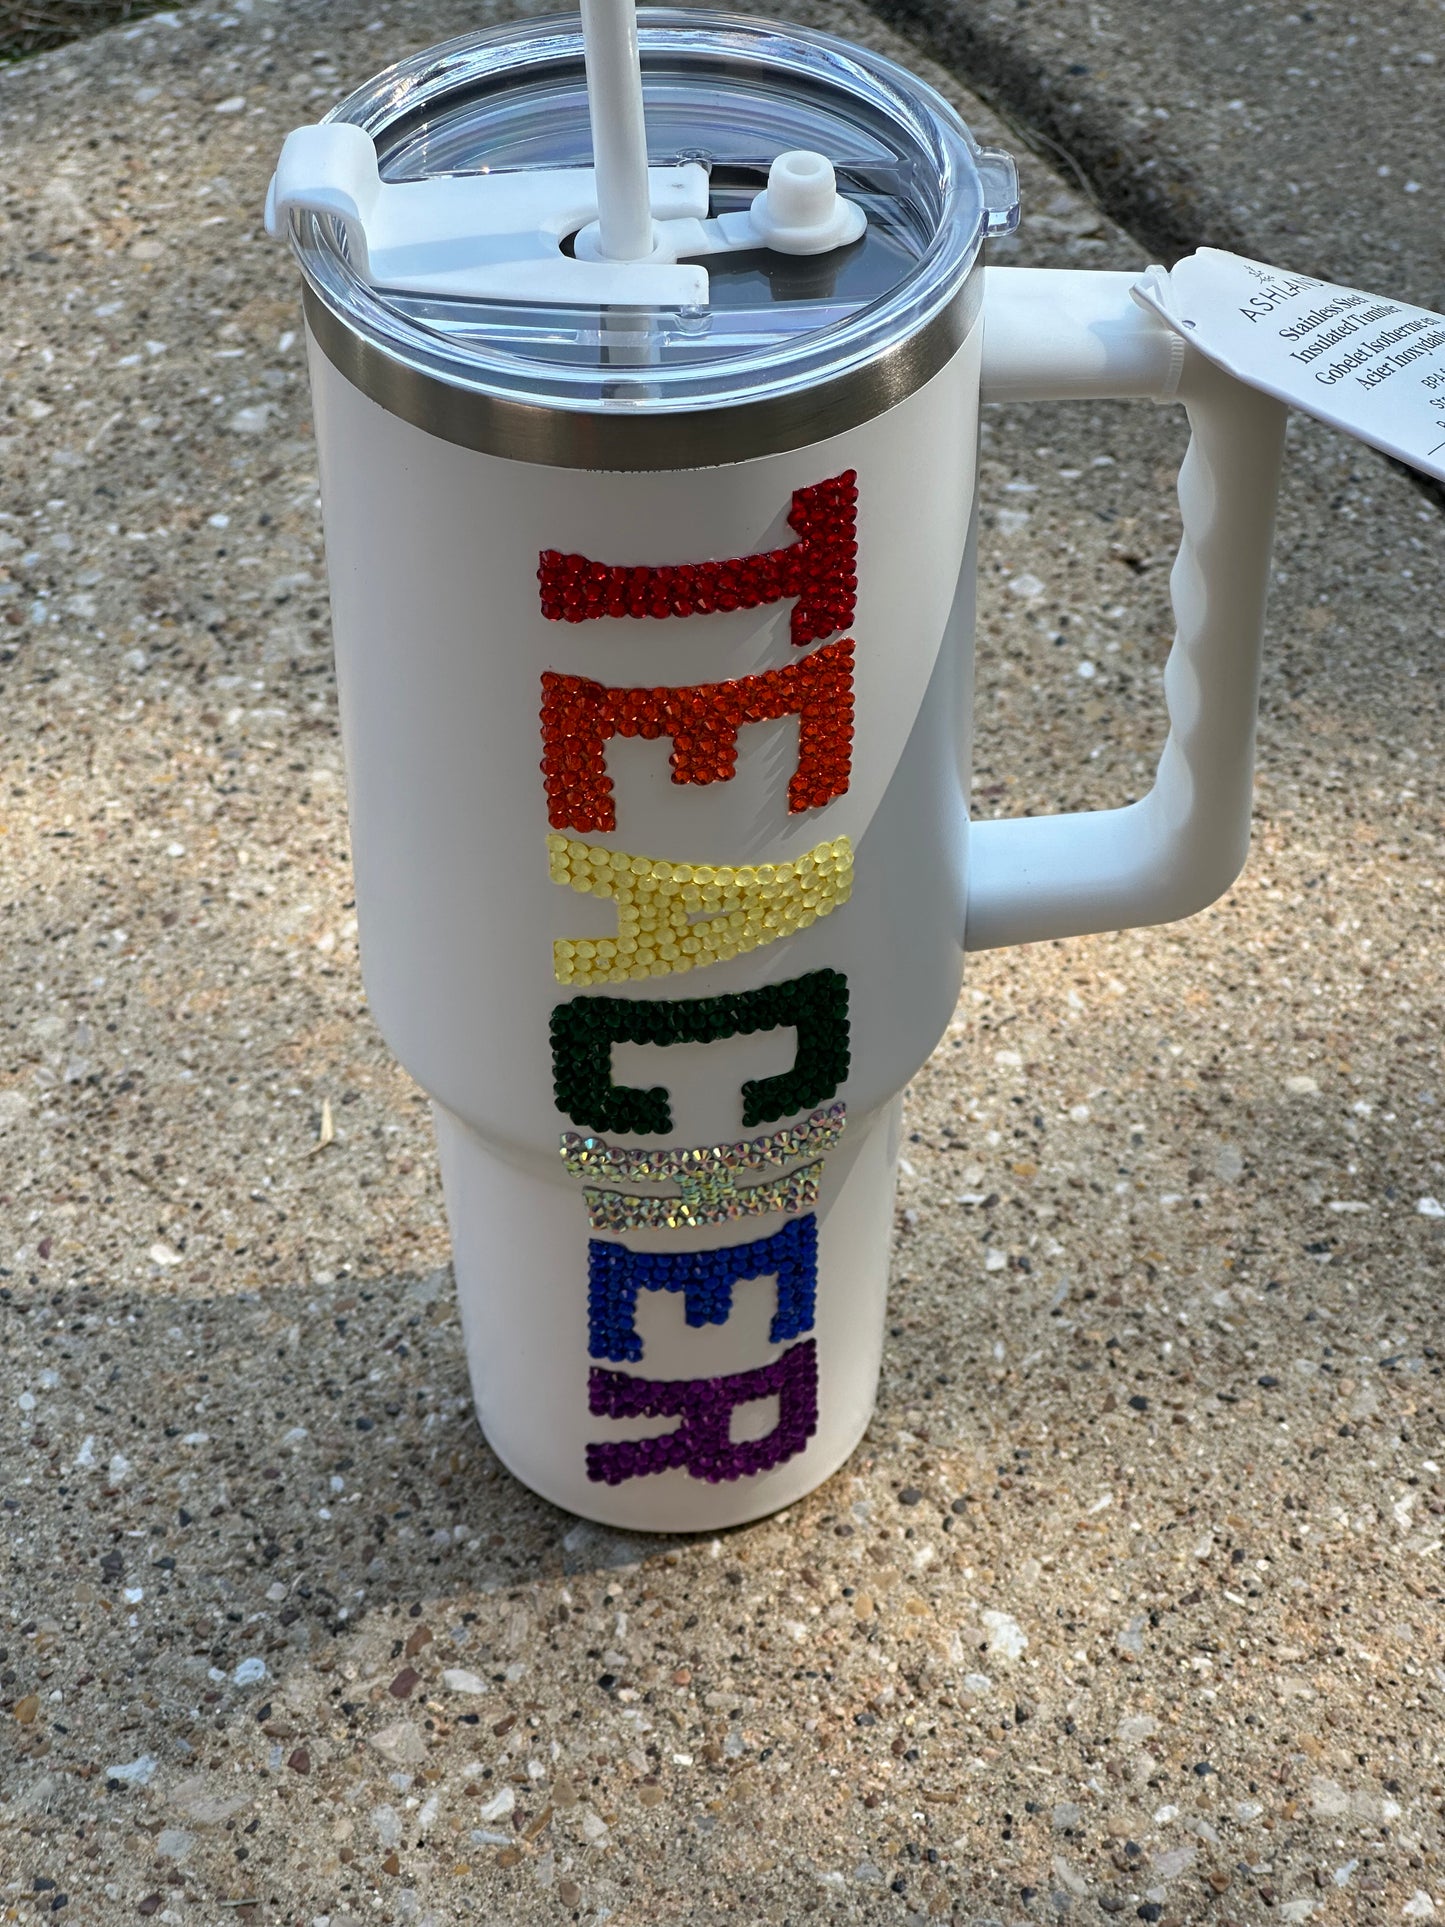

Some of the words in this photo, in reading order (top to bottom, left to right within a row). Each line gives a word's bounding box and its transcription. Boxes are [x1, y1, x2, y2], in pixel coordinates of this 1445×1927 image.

[1239, 277, 1324, 323] ASHLAND
[1279, 303, 1344, 341] Stainless
[1332, 294, 1370, 309] Steel
[1290, 319, 1359, 364] Insulated
[1347, 305, 1402, 326] Tumbler
[1315, 348, 1373, 385] Gobelet
[1360, 320, 1428, 354] Isotherme
[1355, 362, 1396, 390] Acier
[537, 469, 858, 1485] TEACHER
